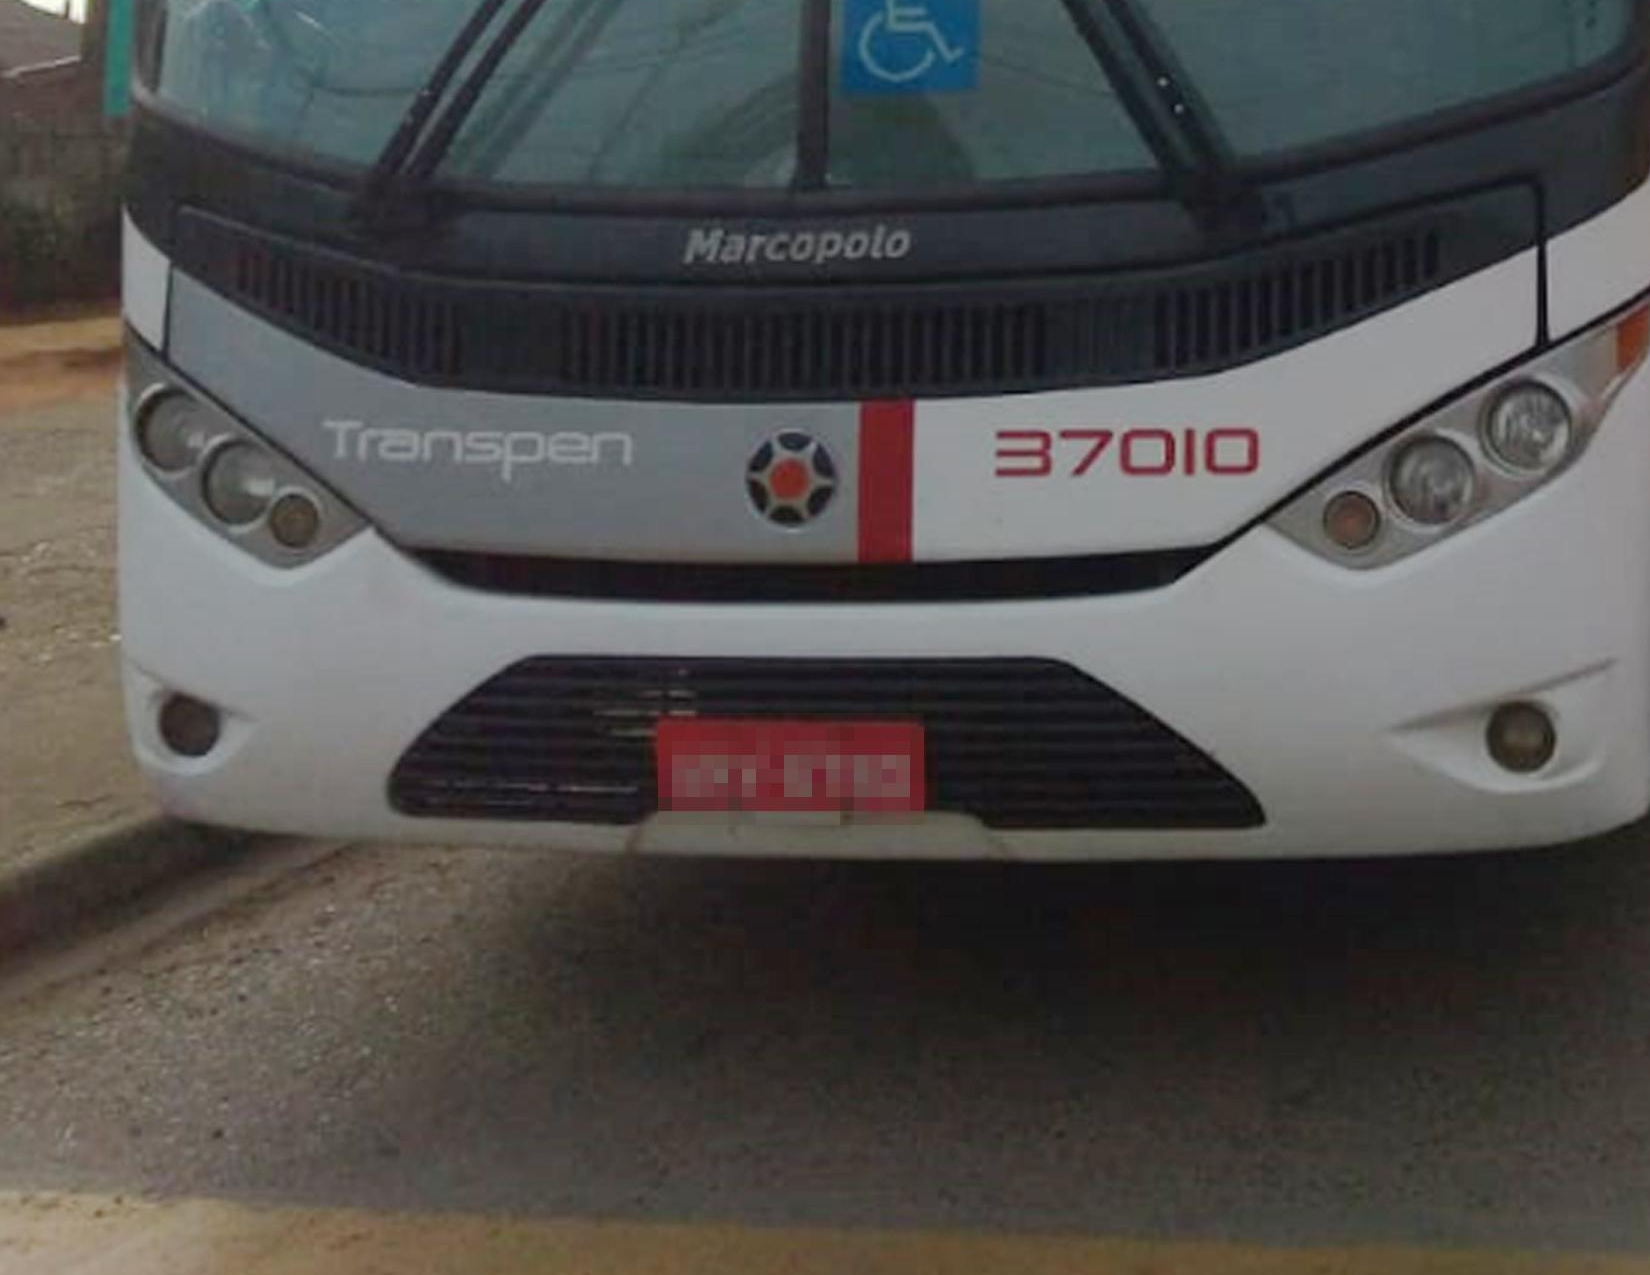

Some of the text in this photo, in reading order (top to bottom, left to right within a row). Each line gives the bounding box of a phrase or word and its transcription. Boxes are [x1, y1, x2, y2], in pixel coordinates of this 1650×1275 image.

[683, 225, 911, 264] Marcopolo
[321, 419, 632, 483] Transpen
[994, 428, 1260, 476] 37010
